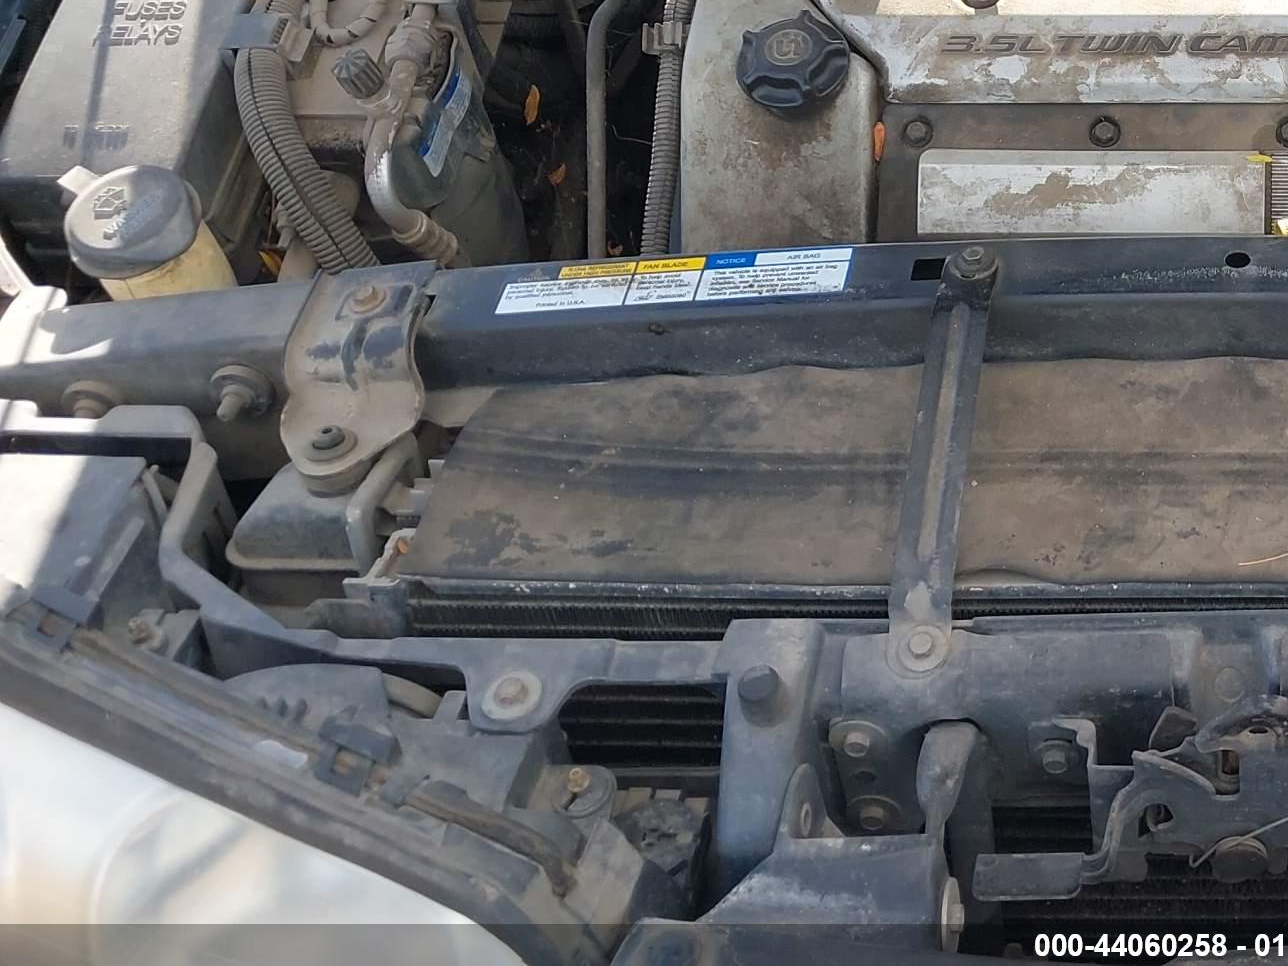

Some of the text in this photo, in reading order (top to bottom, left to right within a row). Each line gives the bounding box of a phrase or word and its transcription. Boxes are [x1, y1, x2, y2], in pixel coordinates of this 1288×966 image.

[112, 0, 187, 22] FUSES
[92, 23, 183, 47] RELAYS
[941, 33, 1045, 54] 3.5L
[1055, 33, 1183, 54] TWIN
[716, 257, 746, 265] NOTICE
